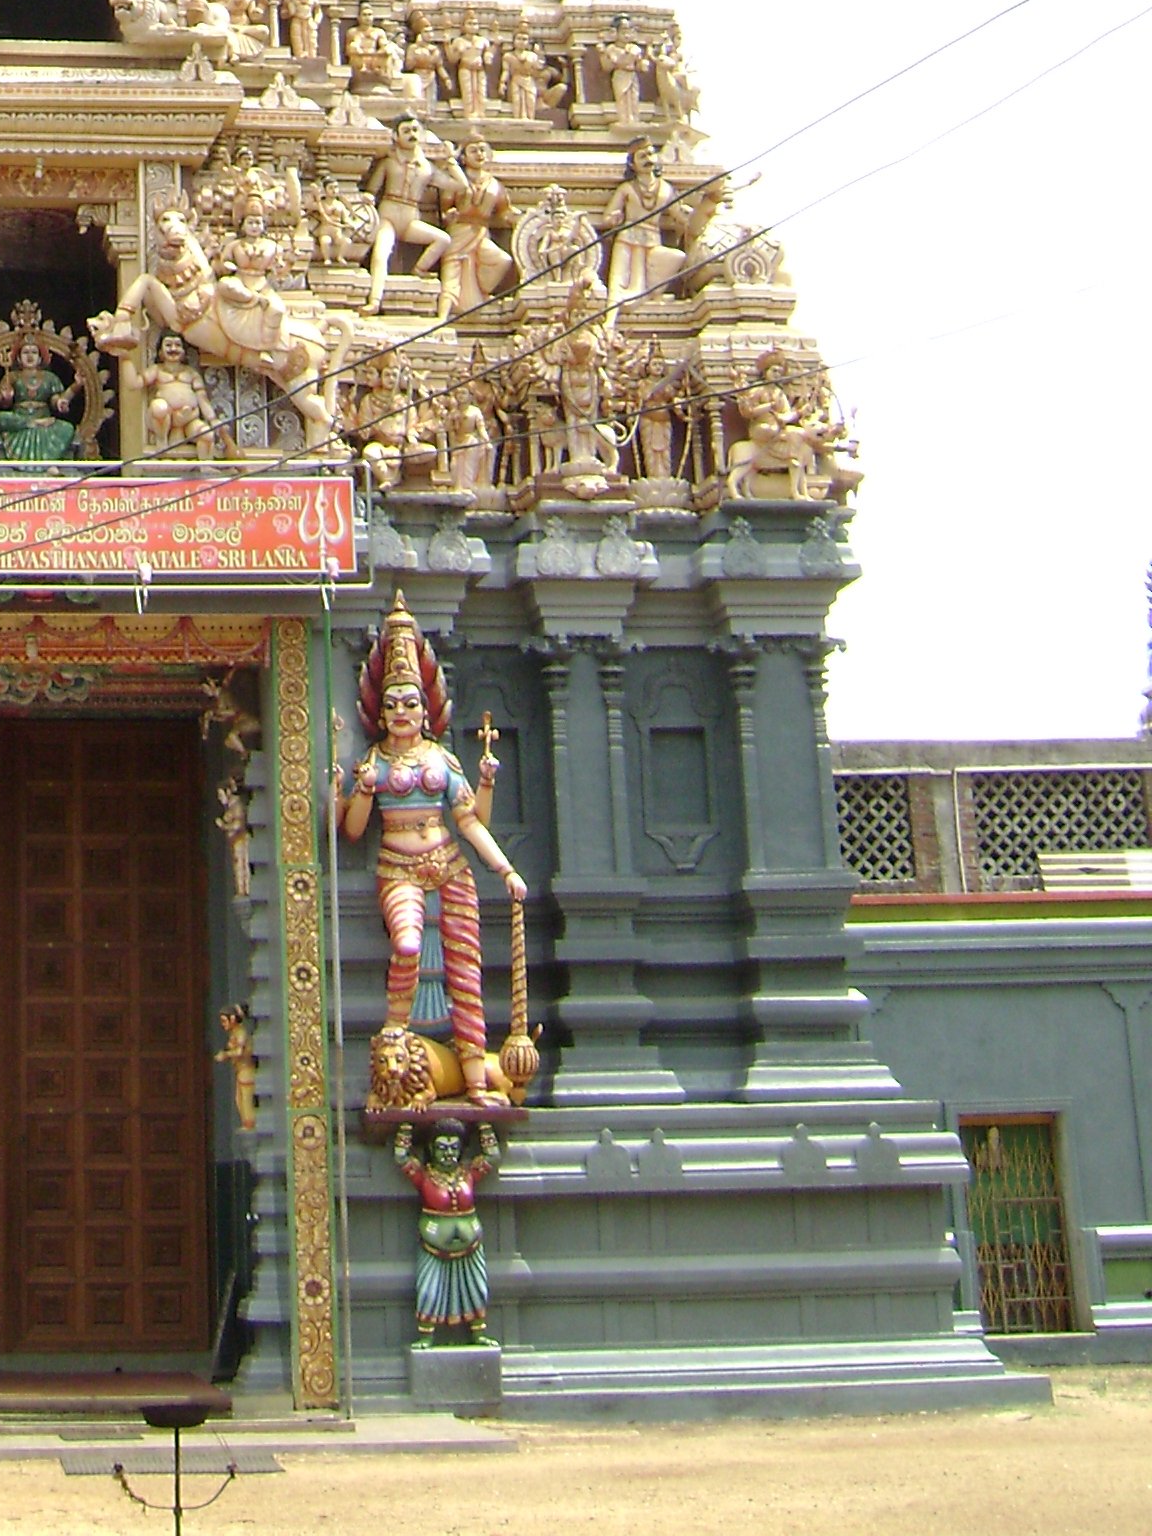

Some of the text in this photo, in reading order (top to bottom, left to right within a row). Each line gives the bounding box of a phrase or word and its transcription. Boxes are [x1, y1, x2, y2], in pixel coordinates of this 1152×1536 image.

[135, 549, 201, 568] MATALE
[216, 549, 246, 568] SRI
[252, 549, 308, 568] LANKA
